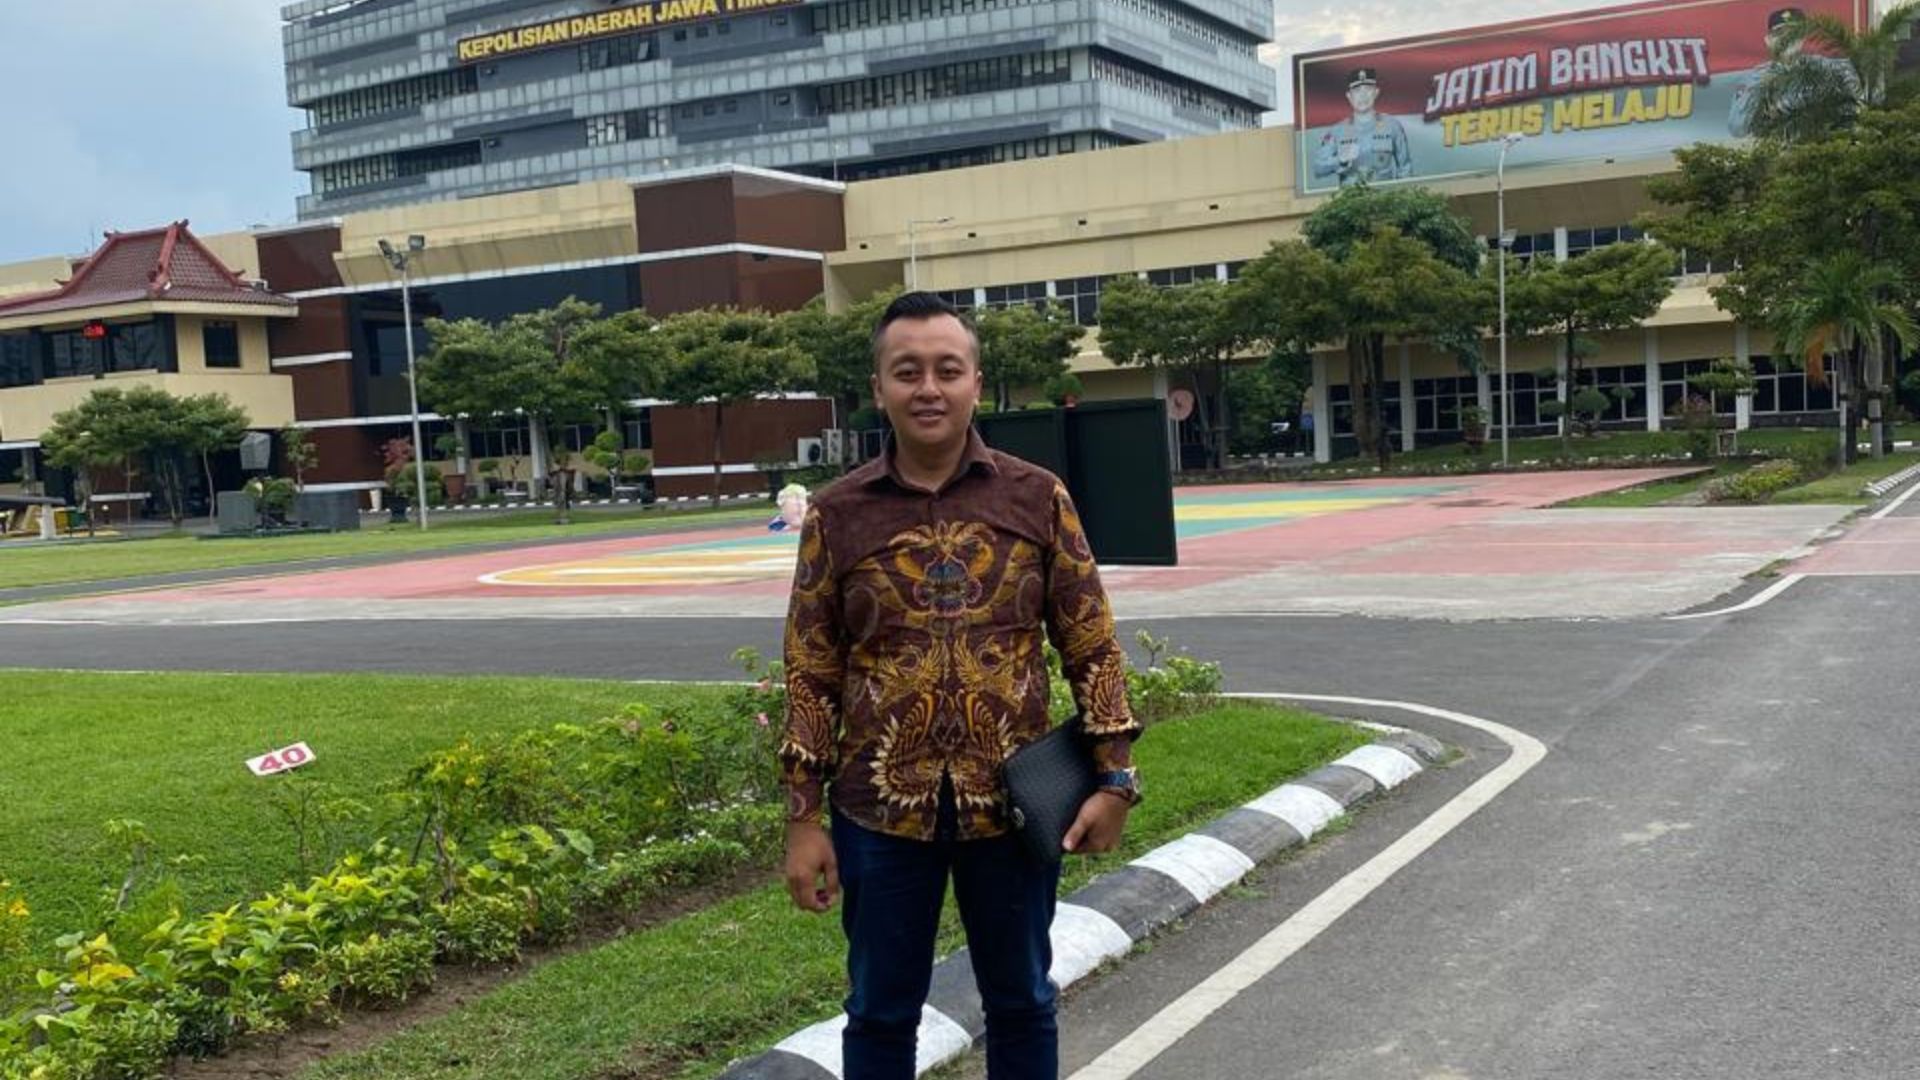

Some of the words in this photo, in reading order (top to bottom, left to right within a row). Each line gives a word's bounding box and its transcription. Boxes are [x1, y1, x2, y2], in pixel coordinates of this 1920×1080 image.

[459, 20, 569, 60] KEPOLISIAN
[571, 4, 654, 38] DAERAH
[656, 0, 720, 22] JAWA
[1425, 52, 1537, 115] JATIM
[1551, 38, 1708, 87] BANGKIT
[1441, 104, 1544, 147] TERUS
[1552, 84, 1693, 133] MELAJU
[259, 747, 306, 771] 40
